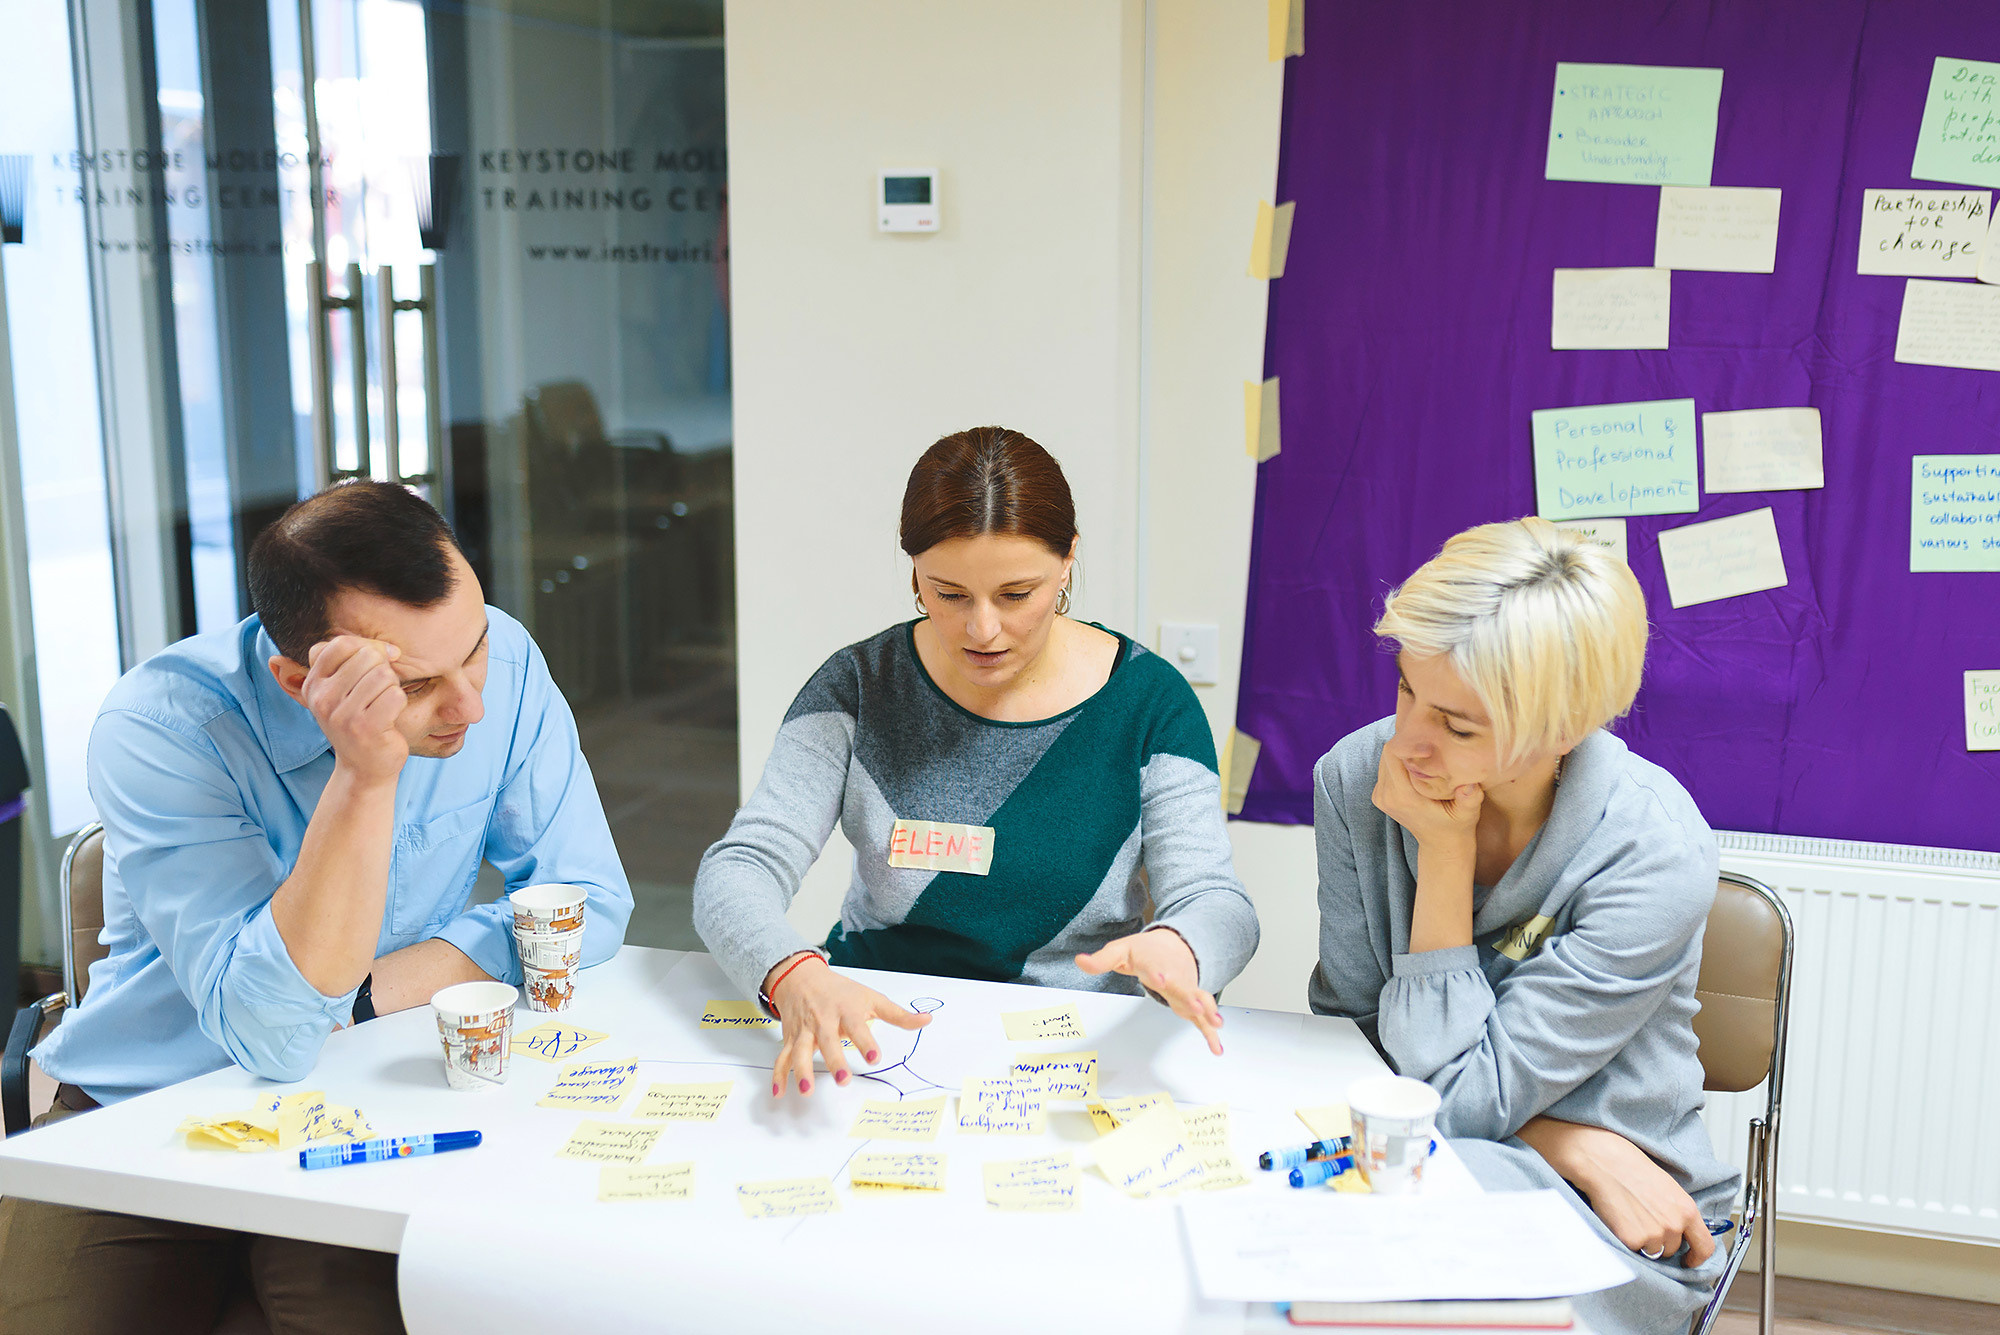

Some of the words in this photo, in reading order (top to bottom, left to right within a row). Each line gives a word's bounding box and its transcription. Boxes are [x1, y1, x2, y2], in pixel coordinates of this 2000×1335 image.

[1570, 84, 1672, 101] STRATEGIC
[1944, 87, 1992, 104] with
[478, 149, 634, 173] KEYSTONE
[653, 148, 729, 173] MOL
[54, 185, 202, 209] TRAINNG
[481, 187, 651, 212] TRAINING
[1873, 194, 1985, 219] Partnerships
[1879, 234, 1977, 261] change
[1554, 413, 1643, 439] Personal
[1556, 445, 1676, 473] Professional
[1558, 478, 1694, 511] Development
[1920, 538, 1969, 551] various
[1979, 697, 1996, 717] of
[892, 828, 983, 862] ELENE
[568, 1065, 625, 1079] change
[626, 1062, 638, 1075] to
[1002, 1097, 1040, 1118] willing
